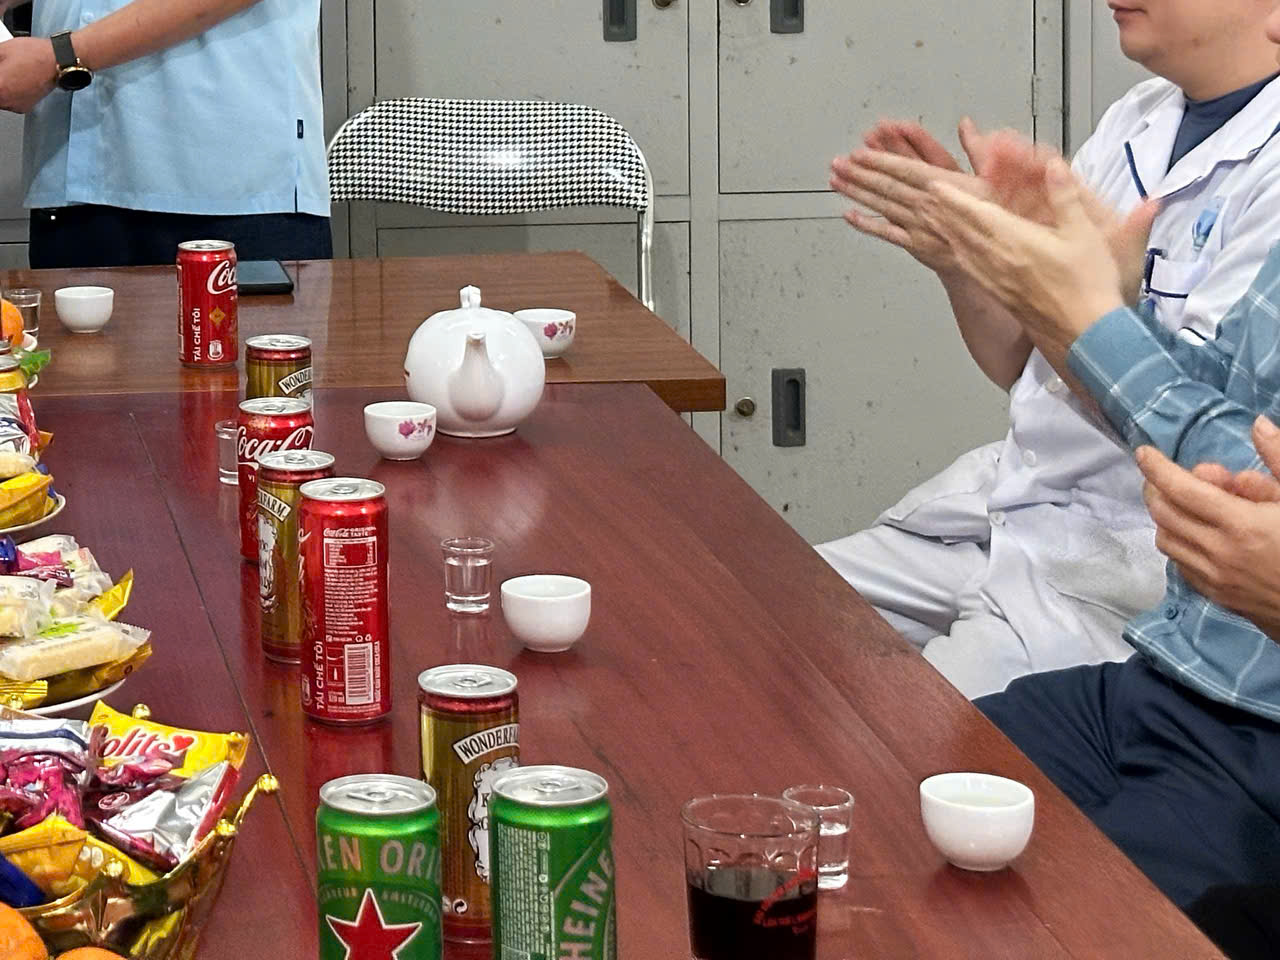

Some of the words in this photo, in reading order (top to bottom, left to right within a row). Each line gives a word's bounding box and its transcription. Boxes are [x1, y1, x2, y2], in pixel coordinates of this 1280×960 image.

[313, 641, 324, 660] TÔI
[312, 661, 324, 689] CHẾ
[314, 691, 326, 710] TÁI
[318, 835, 363, 873] EN
